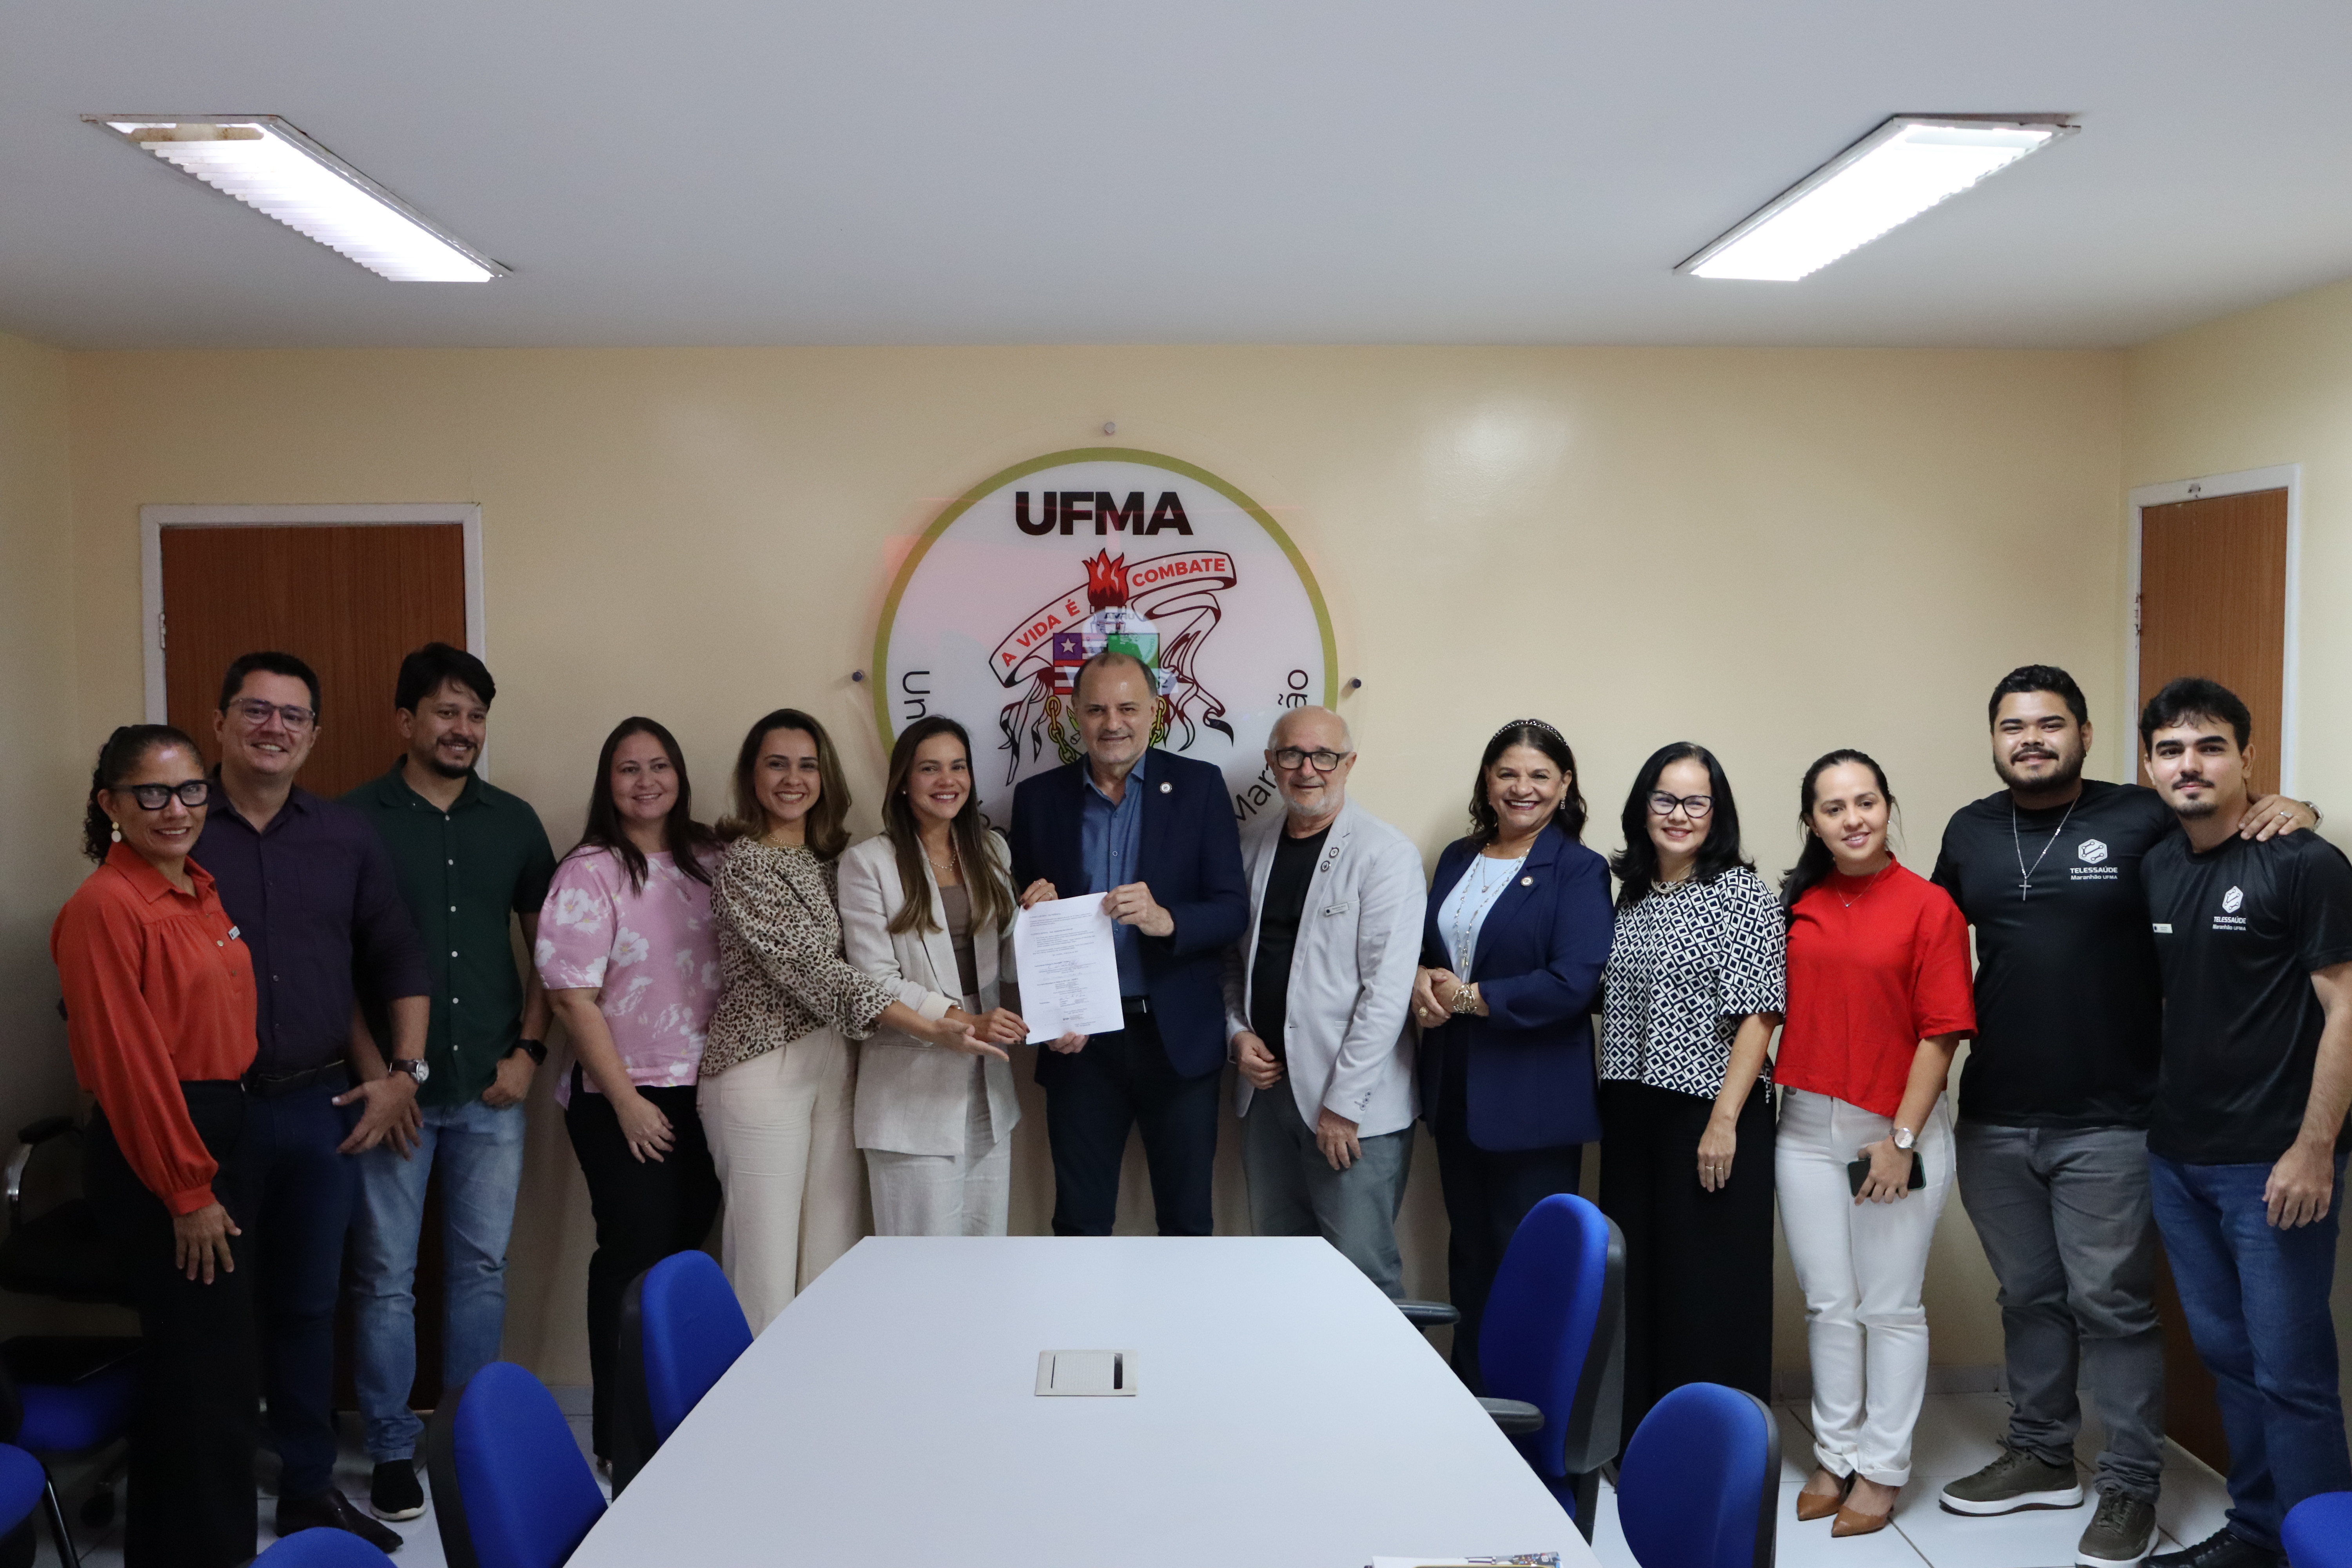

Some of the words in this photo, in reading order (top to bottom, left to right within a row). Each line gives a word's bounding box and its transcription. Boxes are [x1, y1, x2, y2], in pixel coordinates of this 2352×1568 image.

[1016, 491, 1194, 535] UFMA
[1002, 652, 1017, 667] A
[1016, 614, 1062, 647] VIDA
[1065, 599, 1080, 617] É
[1132, 558, 1225, 586] COMBATE
[2213, 916, 2247, 924] TELESSAÚDE
